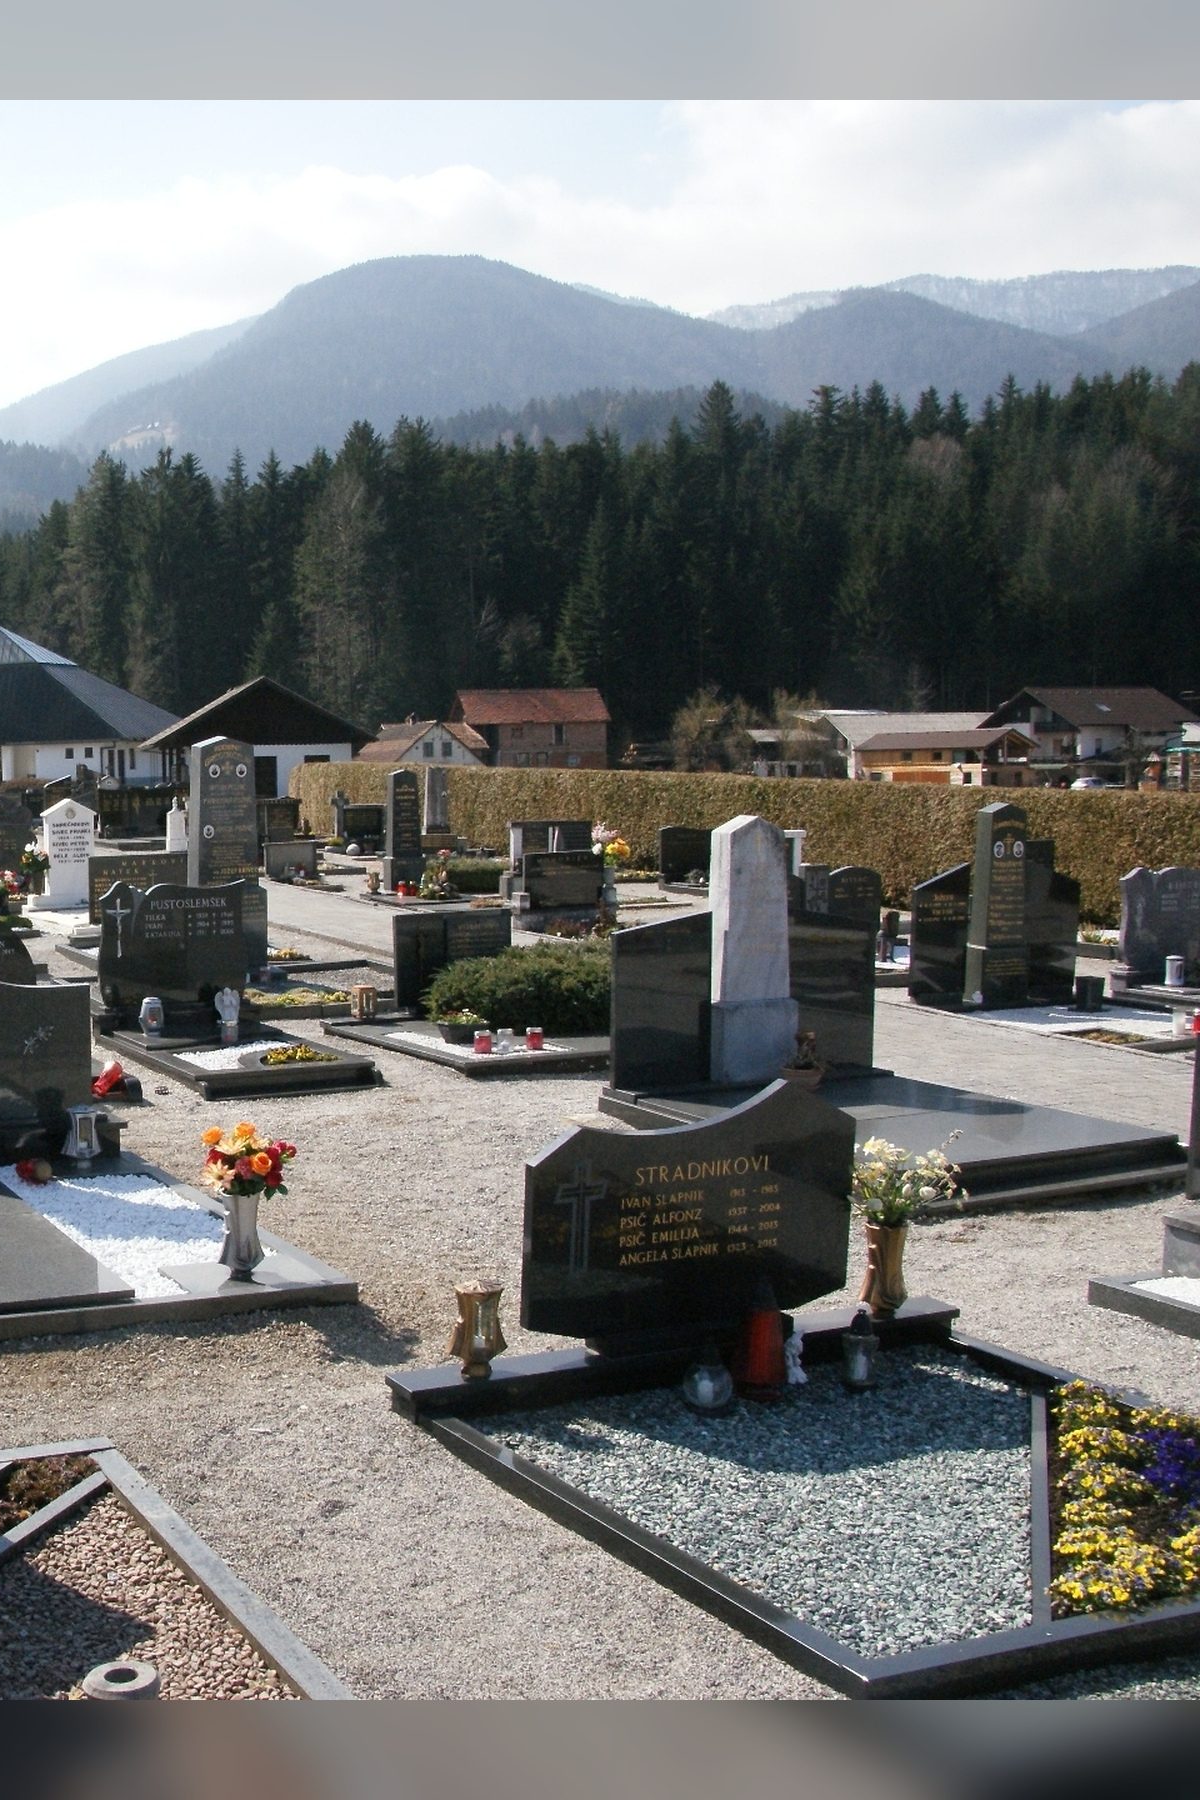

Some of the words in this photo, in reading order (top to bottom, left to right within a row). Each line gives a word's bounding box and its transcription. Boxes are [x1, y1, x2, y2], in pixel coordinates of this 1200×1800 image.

[635, 1154, 769, 1187] STRADNIKOVI
[620, 1196, 651, 1211] IVAN
[655, 1189, 704, 1207] SLAPNIK
[620, 1212, 646, 1229] PSIČ
[652, 1207, 703, 1226] ALFONZ
[728, 1205, 748, 1217] 1937
[619, 1231, 646, 1248] PSIČ
[652, 1227, 700, 1244] EMILIJA
[619, 1249, 668, 1266] ANGELA
[671, 1242, 720, 1261] SLAPNIK
